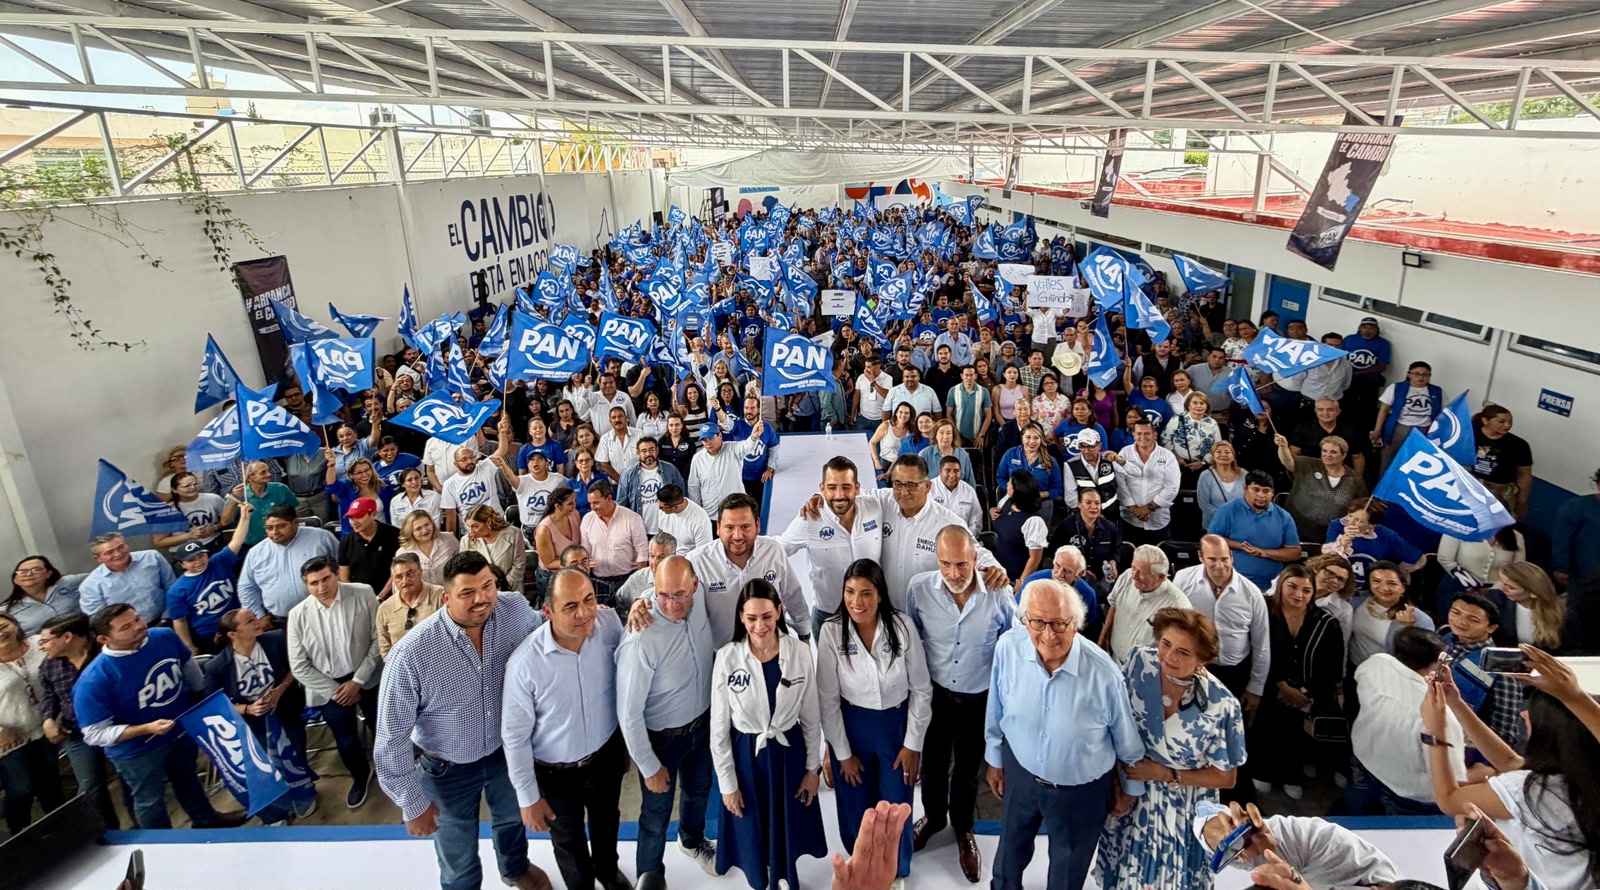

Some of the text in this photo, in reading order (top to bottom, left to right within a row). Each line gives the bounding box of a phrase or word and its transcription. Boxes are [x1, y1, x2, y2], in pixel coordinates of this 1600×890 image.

[1339, 142, 1390, 162] EL CAMBIO
[448, 191, 556, 262] EL CAMBIO
[744, 229, 767, 240] PAN
[509, 256, 526, 288] EN
[528, 248, 551, 281] ACCI
[539, 279, 556, 294] PA
[255, 311, 264, 320] EL
[858, 306, 880, 329] PA
[564, 325, 596, 349] PAN
[601, 319, 649, 349] PAN
[745, 327, 761, 335] PAN
[518, 329, 581, 360] PAN
[771, 342, 827, 370] PAN
[1349, 352, 1377, 365] PAN
[1540, 393, 1572, 411] PRENSA
[1064, 437, 1080, 450] PA
[460, 481, 487, 504] PAN
[640, 482, 662, 494] PAN
[526, 495, 549, 507] PA
[190, 512, 213, 526] AN
[819, 528, 835, 539] PAN
[916, 543, 936, 553] DAHU
[764, 572, 777, 581] PAN
[194, 578, 235, 615] PAN
[138, 663, 183, 710] PAN
[236, 667, 276, 694] PAN
[727, 673, 751, 687] PAN
